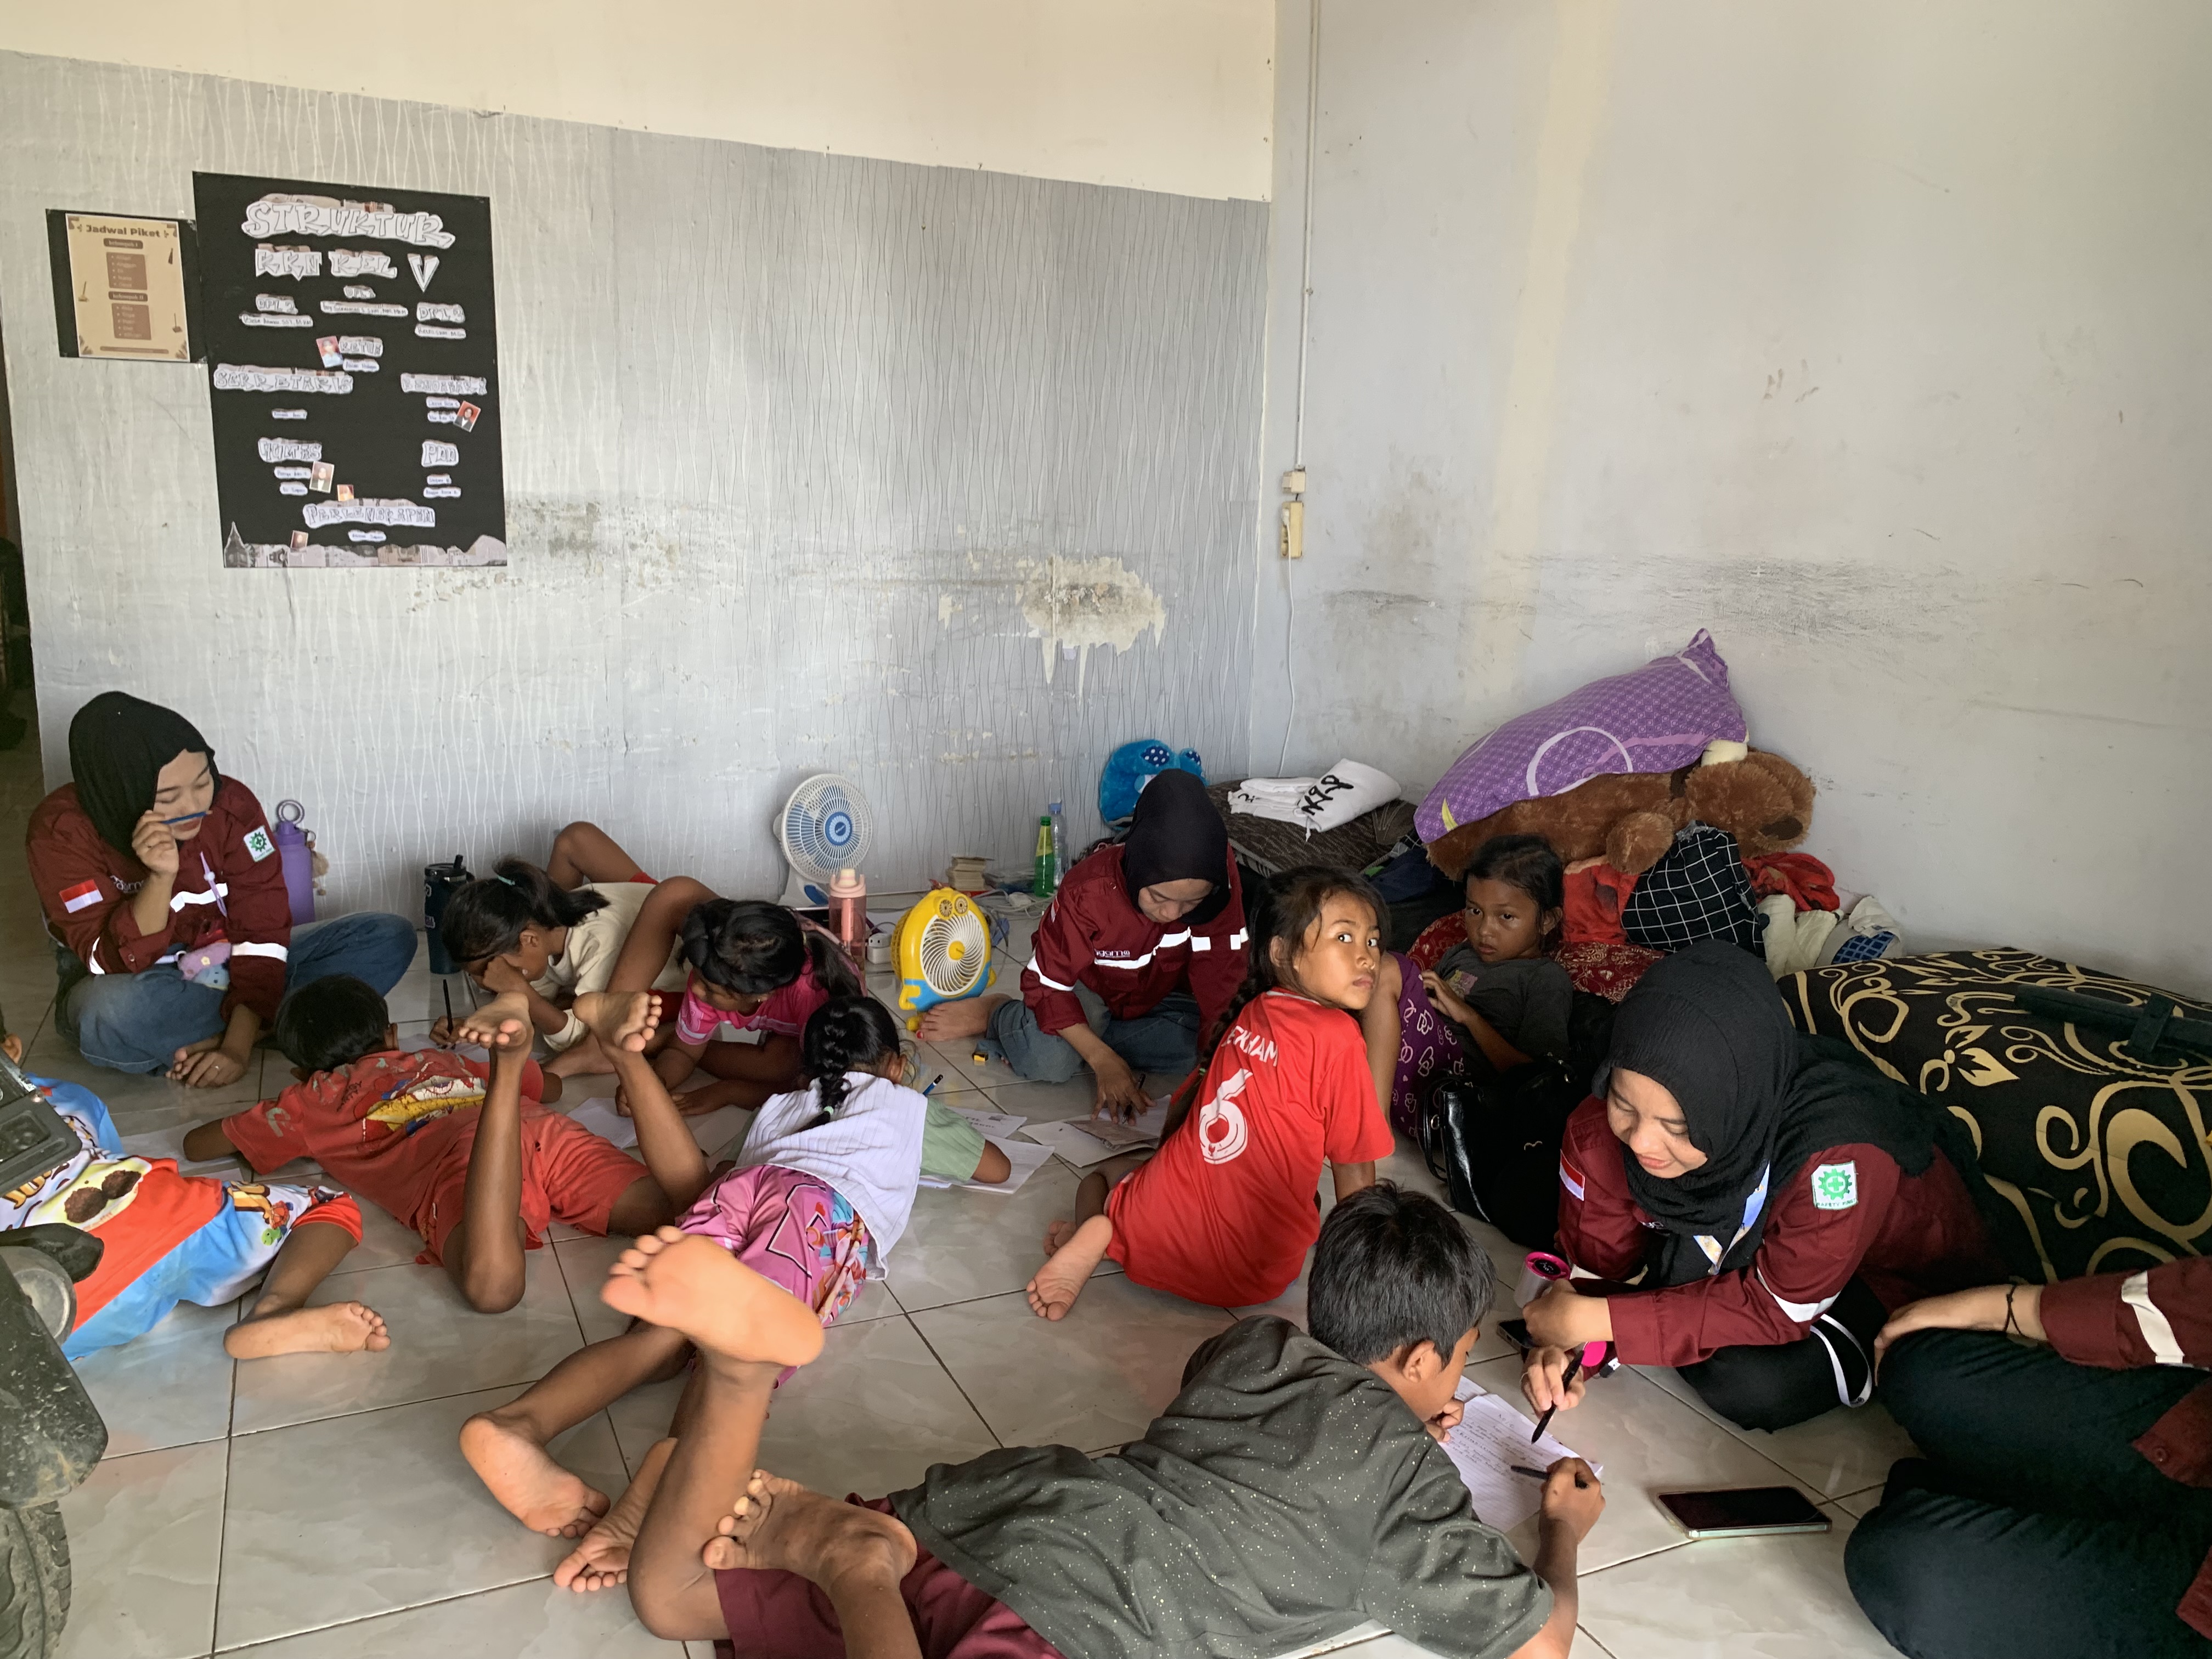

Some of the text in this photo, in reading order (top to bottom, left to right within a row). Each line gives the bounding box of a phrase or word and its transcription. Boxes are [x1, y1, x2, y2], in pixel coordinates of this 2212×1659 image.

[86, 224, 161, 238] Jadwal Piket
[243, 202, 455, 247] STRUKTUR
[257, 250, 439, 292] KKN KEL V
[258, 300, 298, 314] DPL 2
[419, 307, 450, 321] DPL
[215, 368, 354, 393] SEKRETARIS
[259, 439, 322, 461] HUMAS
[306, 504, 435, 526] PERLENGKAPAN
[1199, 1068, 1254, 1165] 6
